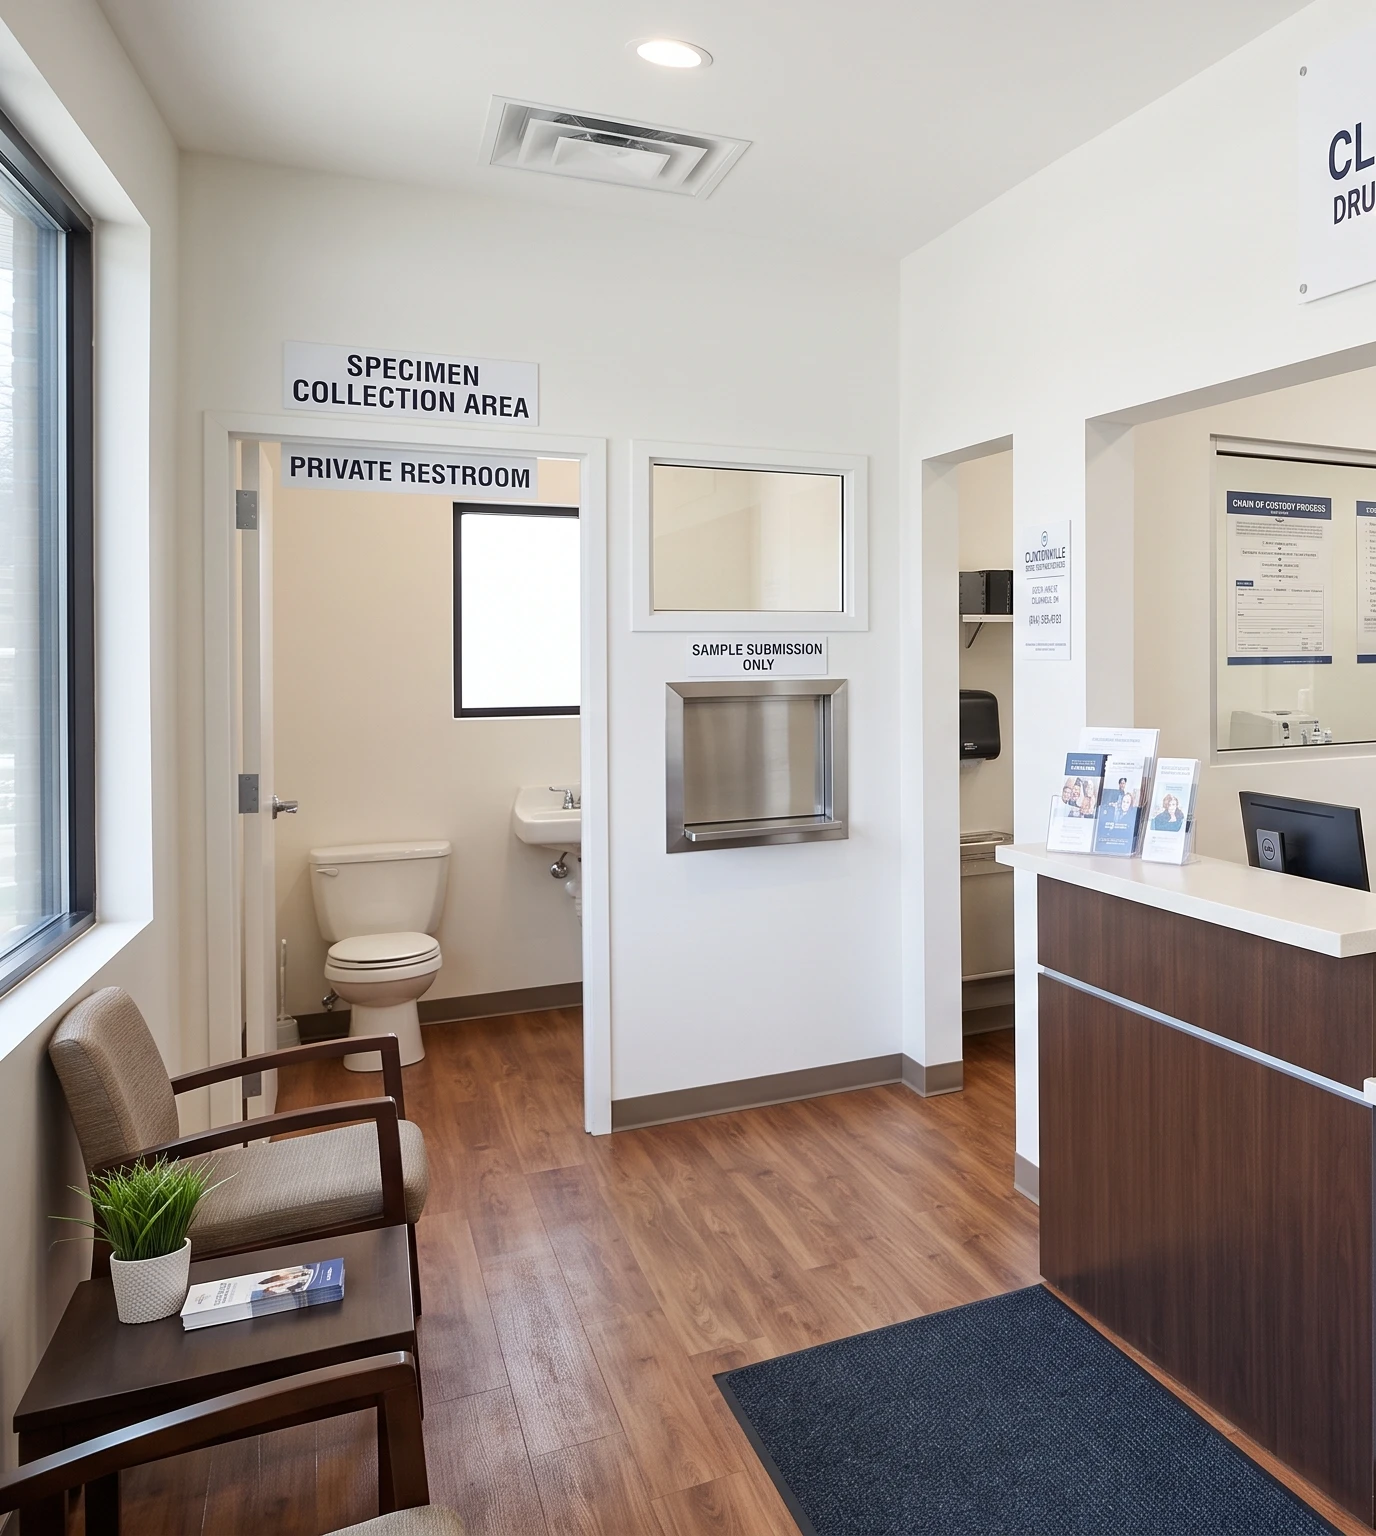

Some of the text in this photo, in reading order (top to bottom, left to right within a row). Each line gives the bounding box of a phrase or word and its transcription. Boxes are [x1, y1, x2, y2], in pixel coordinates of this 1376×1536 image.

[347, 354, 479, 387] SPECIMEN
[293, 379, 530, 419] COLLECTION AREA
[290, 455, 531, 489] PRIVATE RESTROOM
[1232, 499, 1254, 509] CHAIN
[1255, 500, 1264, 509] OF
[692, 643, 823, 656] SAMPLE SUBMISSION
[742, 658, 775, 671] ONLY
